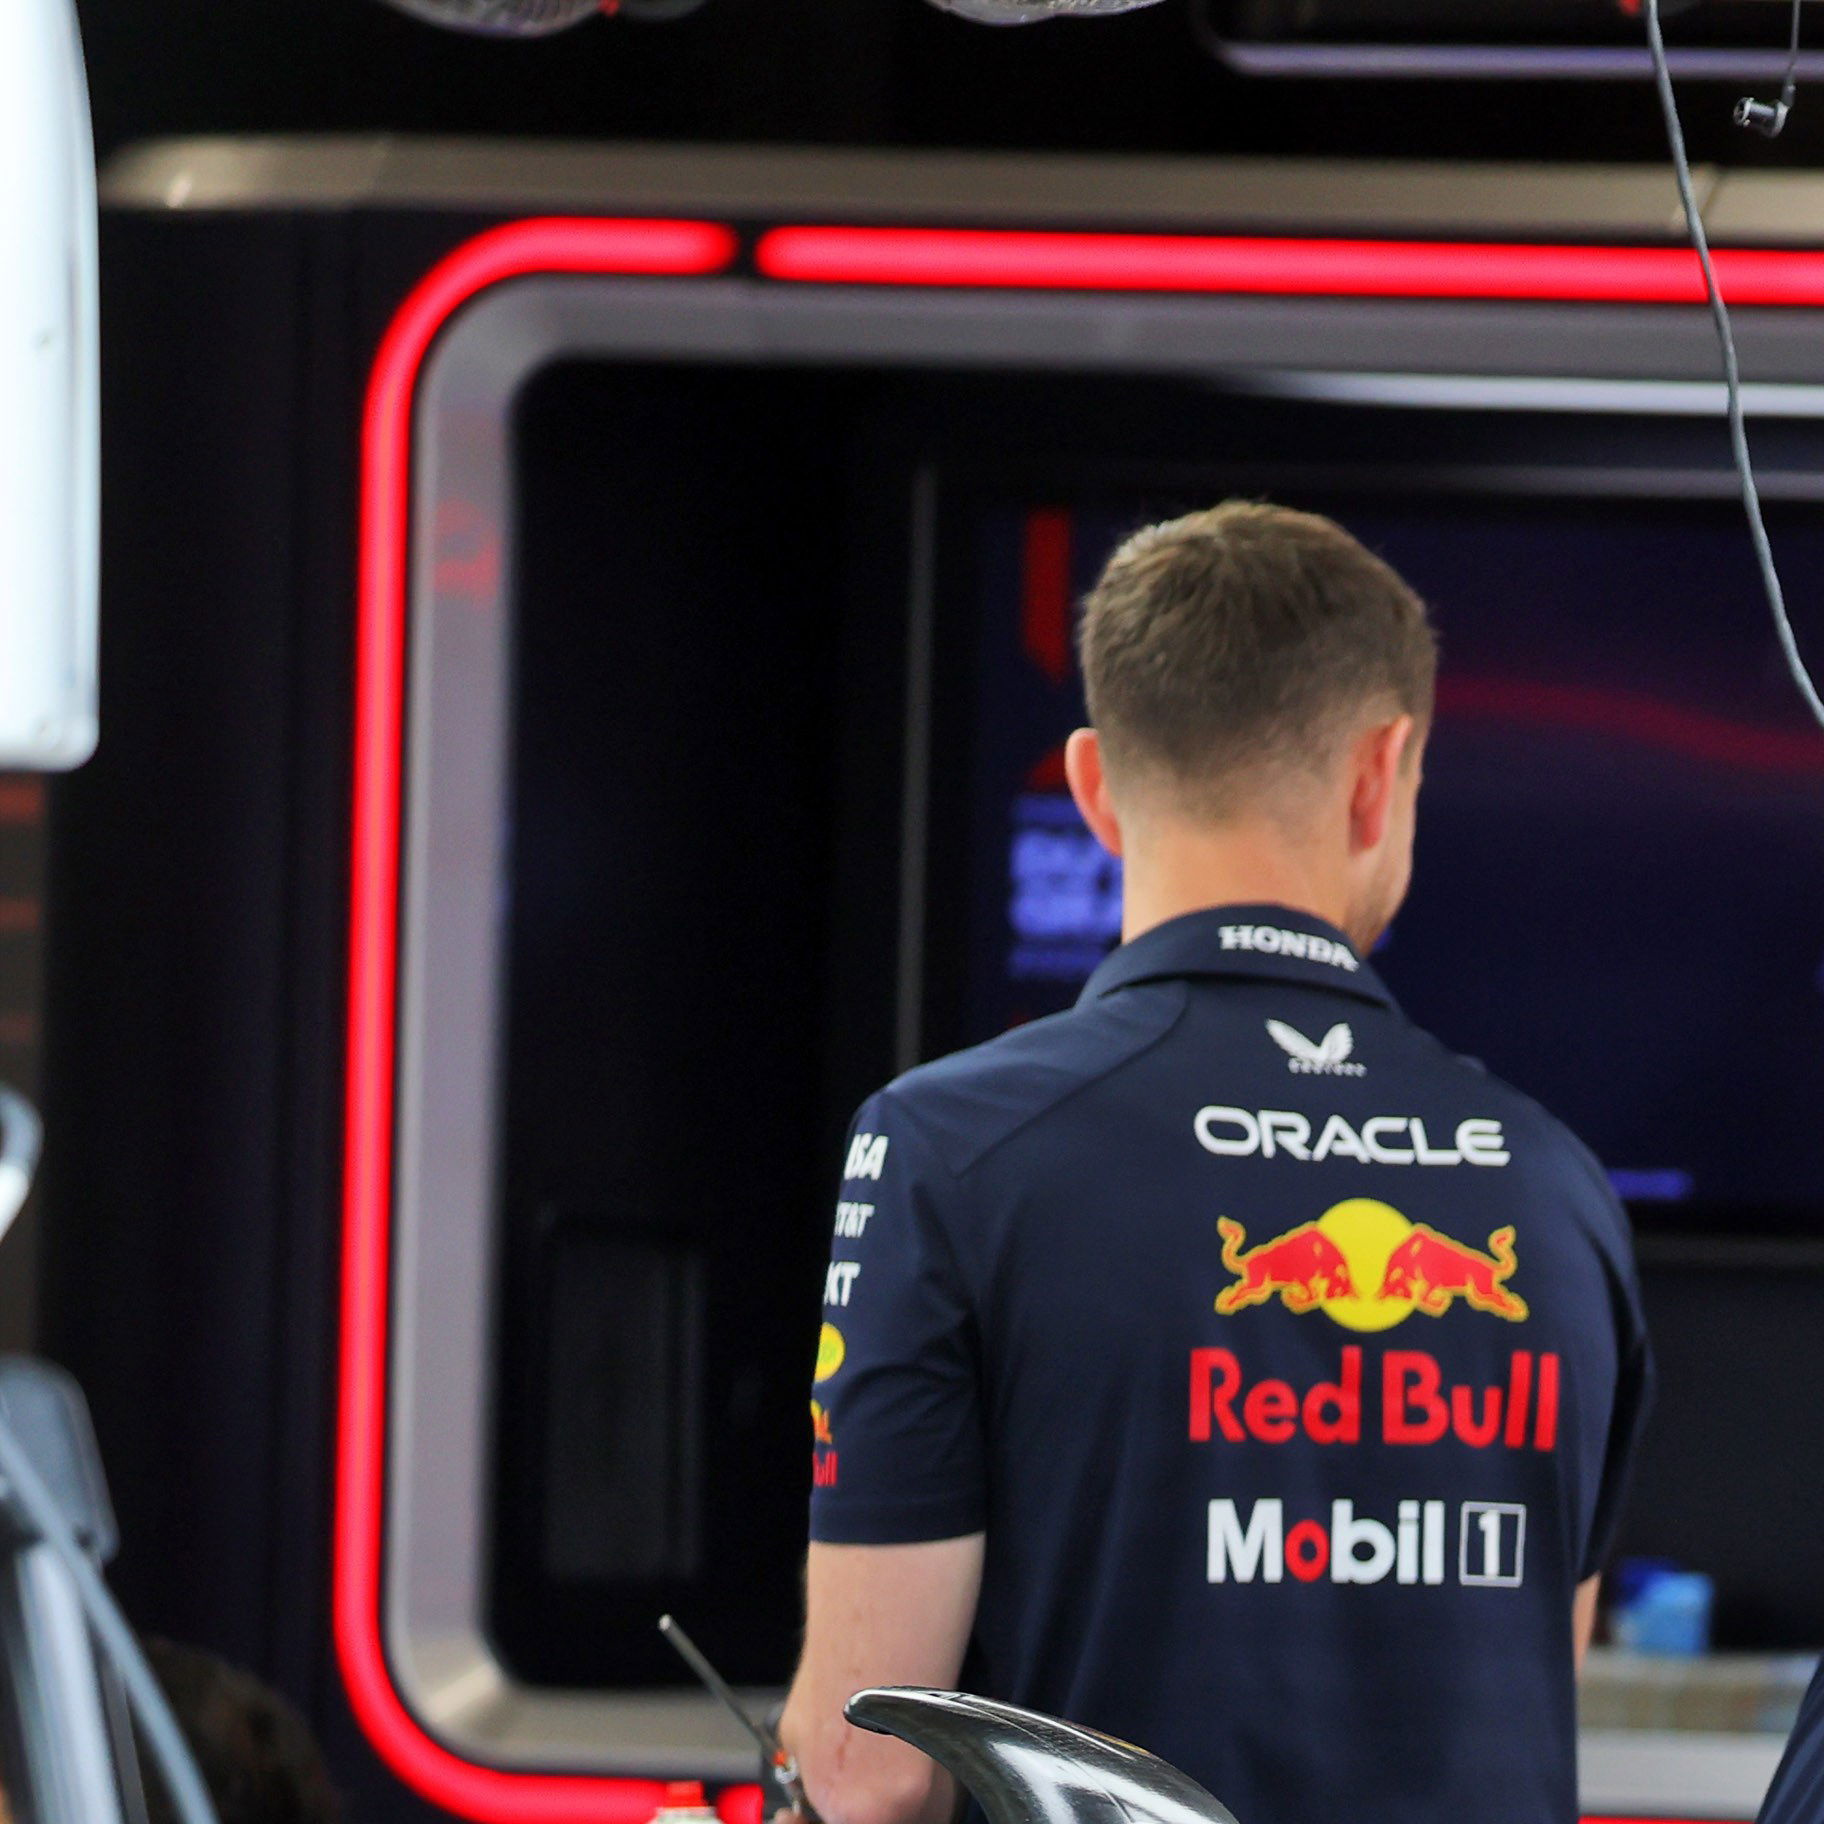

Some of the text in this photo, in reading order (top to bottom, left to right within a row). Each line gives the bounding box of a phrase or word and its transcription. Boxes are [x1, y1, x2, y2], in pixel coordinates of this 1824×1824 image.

[1218, 924, 1360, 973] HONDA
[1194, 1105, 1511, 1167] ORACLE
[1189, 1346, 1559, 1452] Red Bull
[1207, 1499, 1446, 1586] Mobil
